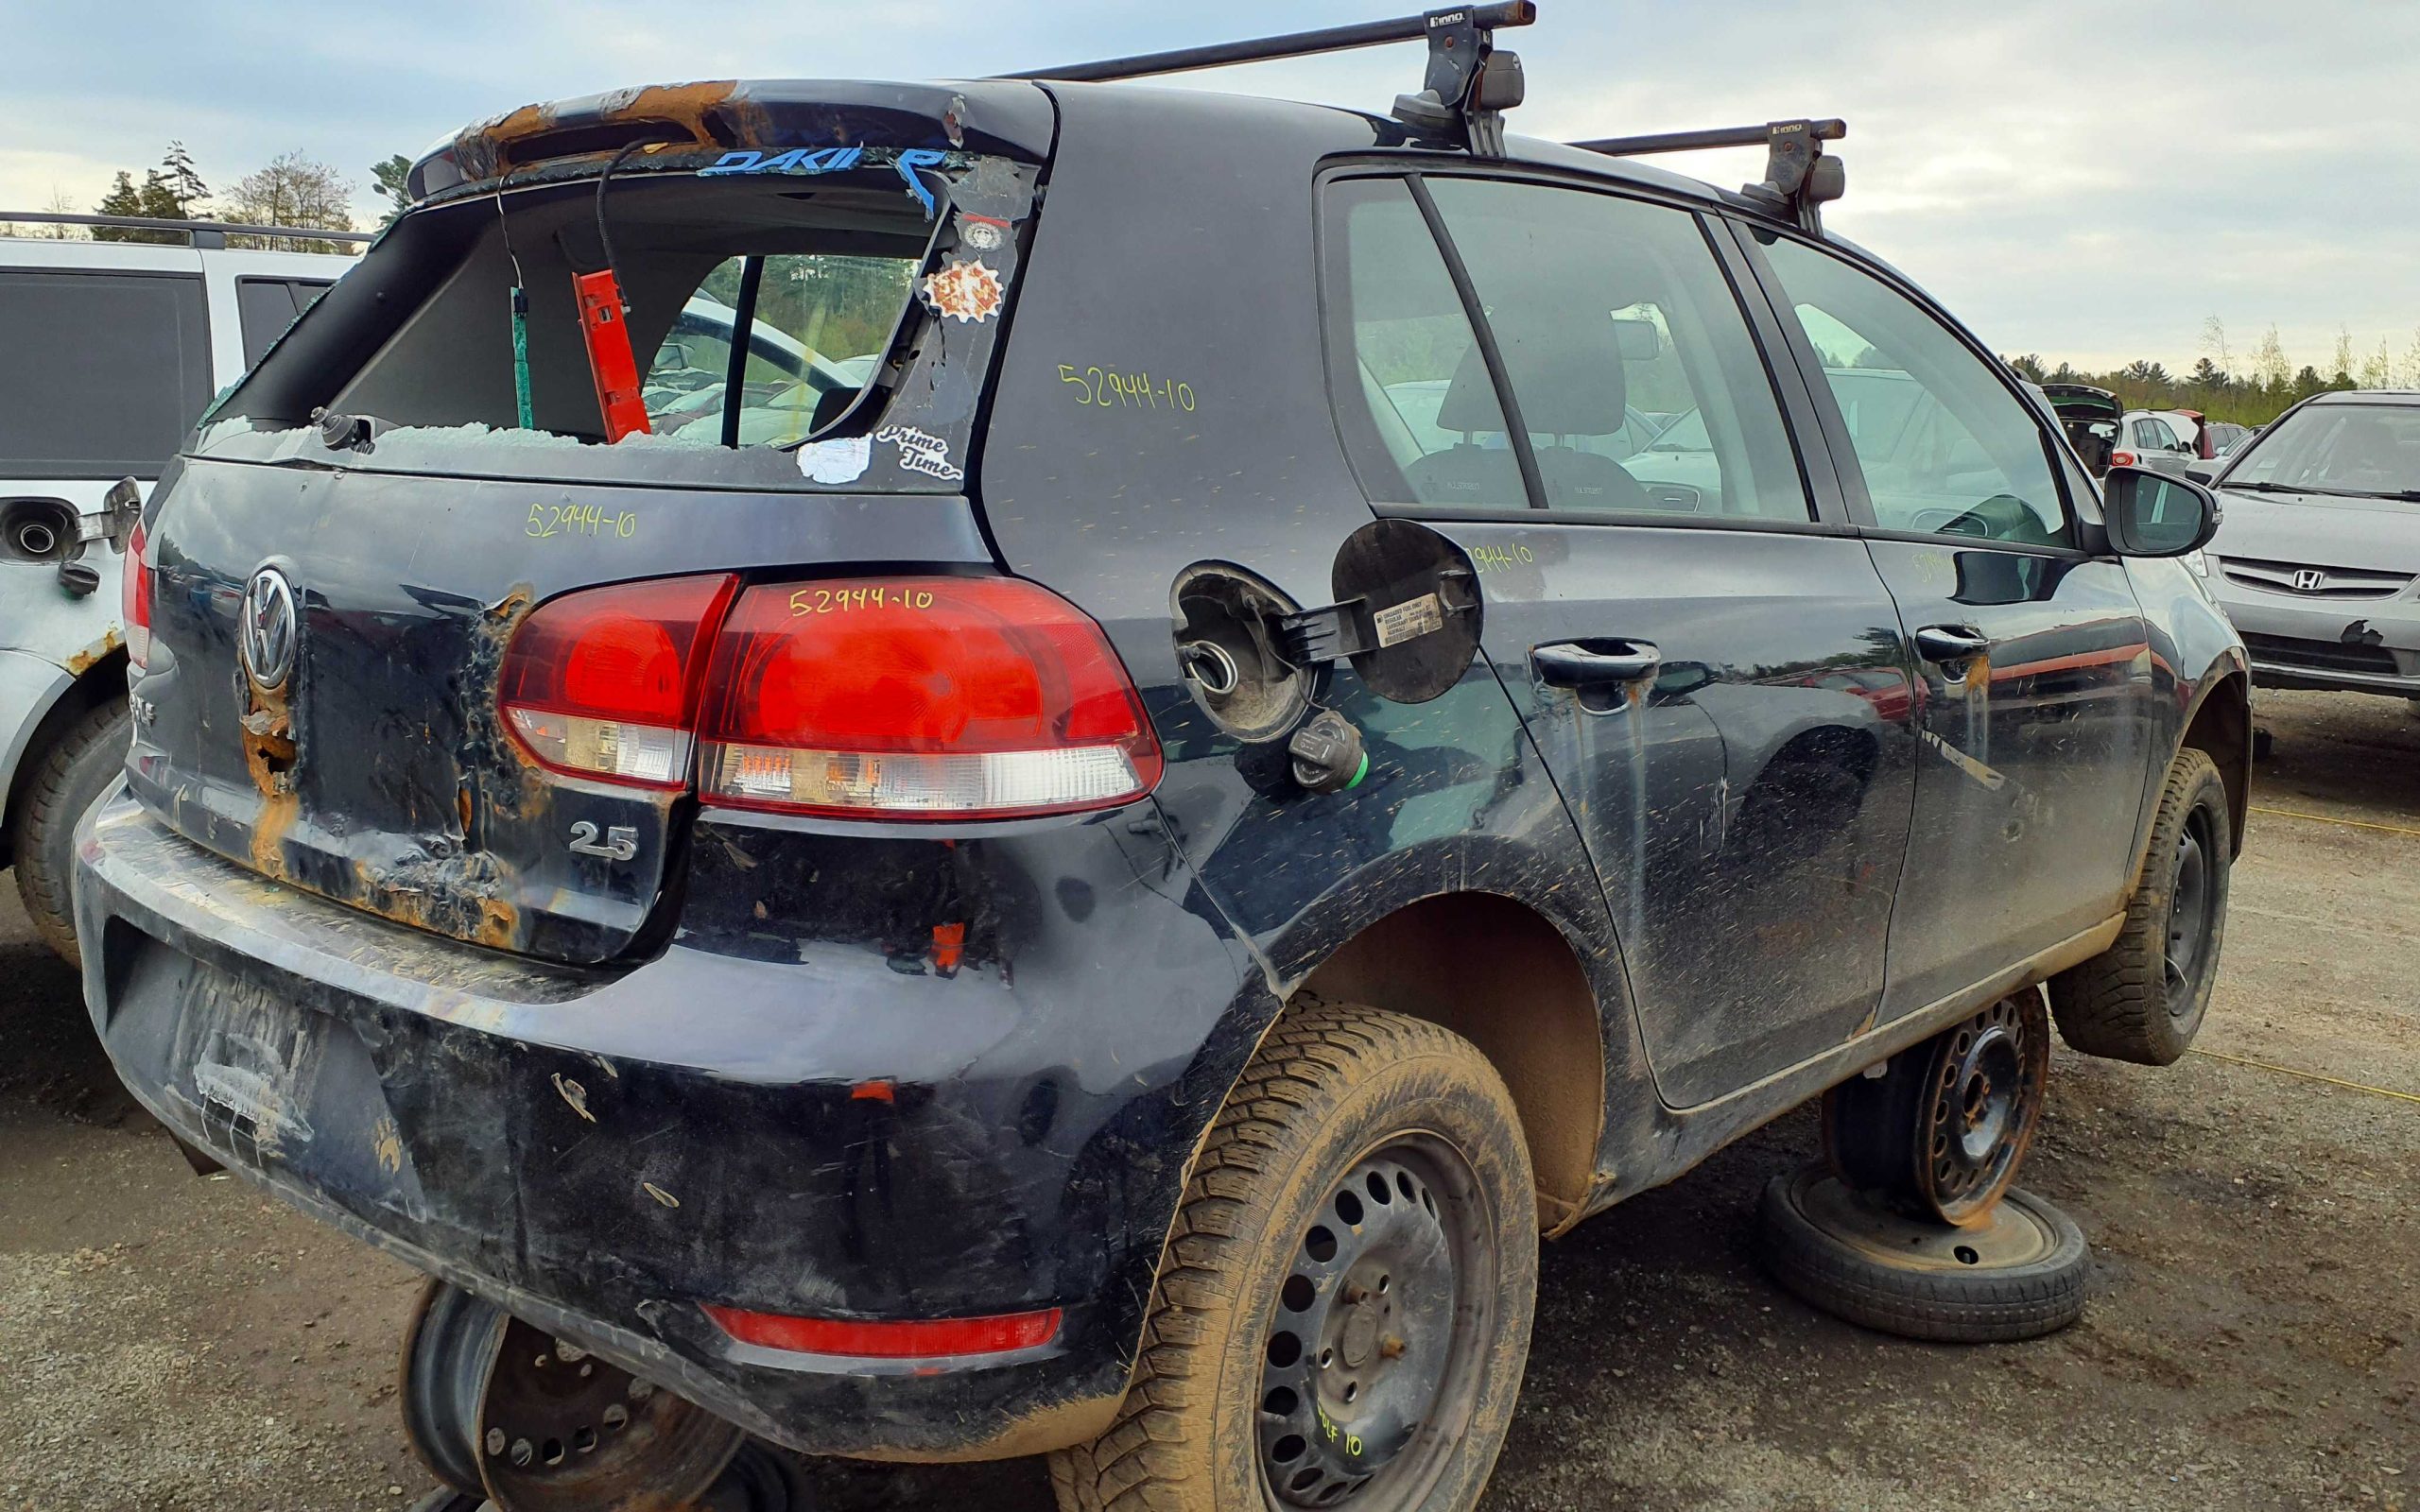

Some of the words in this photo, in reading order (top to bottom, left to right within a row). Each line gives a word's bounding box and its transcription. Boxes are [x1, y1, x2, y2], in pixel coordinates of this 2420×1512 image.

[1057, 364, 1196, 412] 52944-10
[879, 425, 945, 453] Prime
[902, 445, 961, 477] Time
[525, 503, 636, 539] 52944-10
[789, 587, 934, 617] 52944-10
[1346, 1433, 1362, 1456] 10
